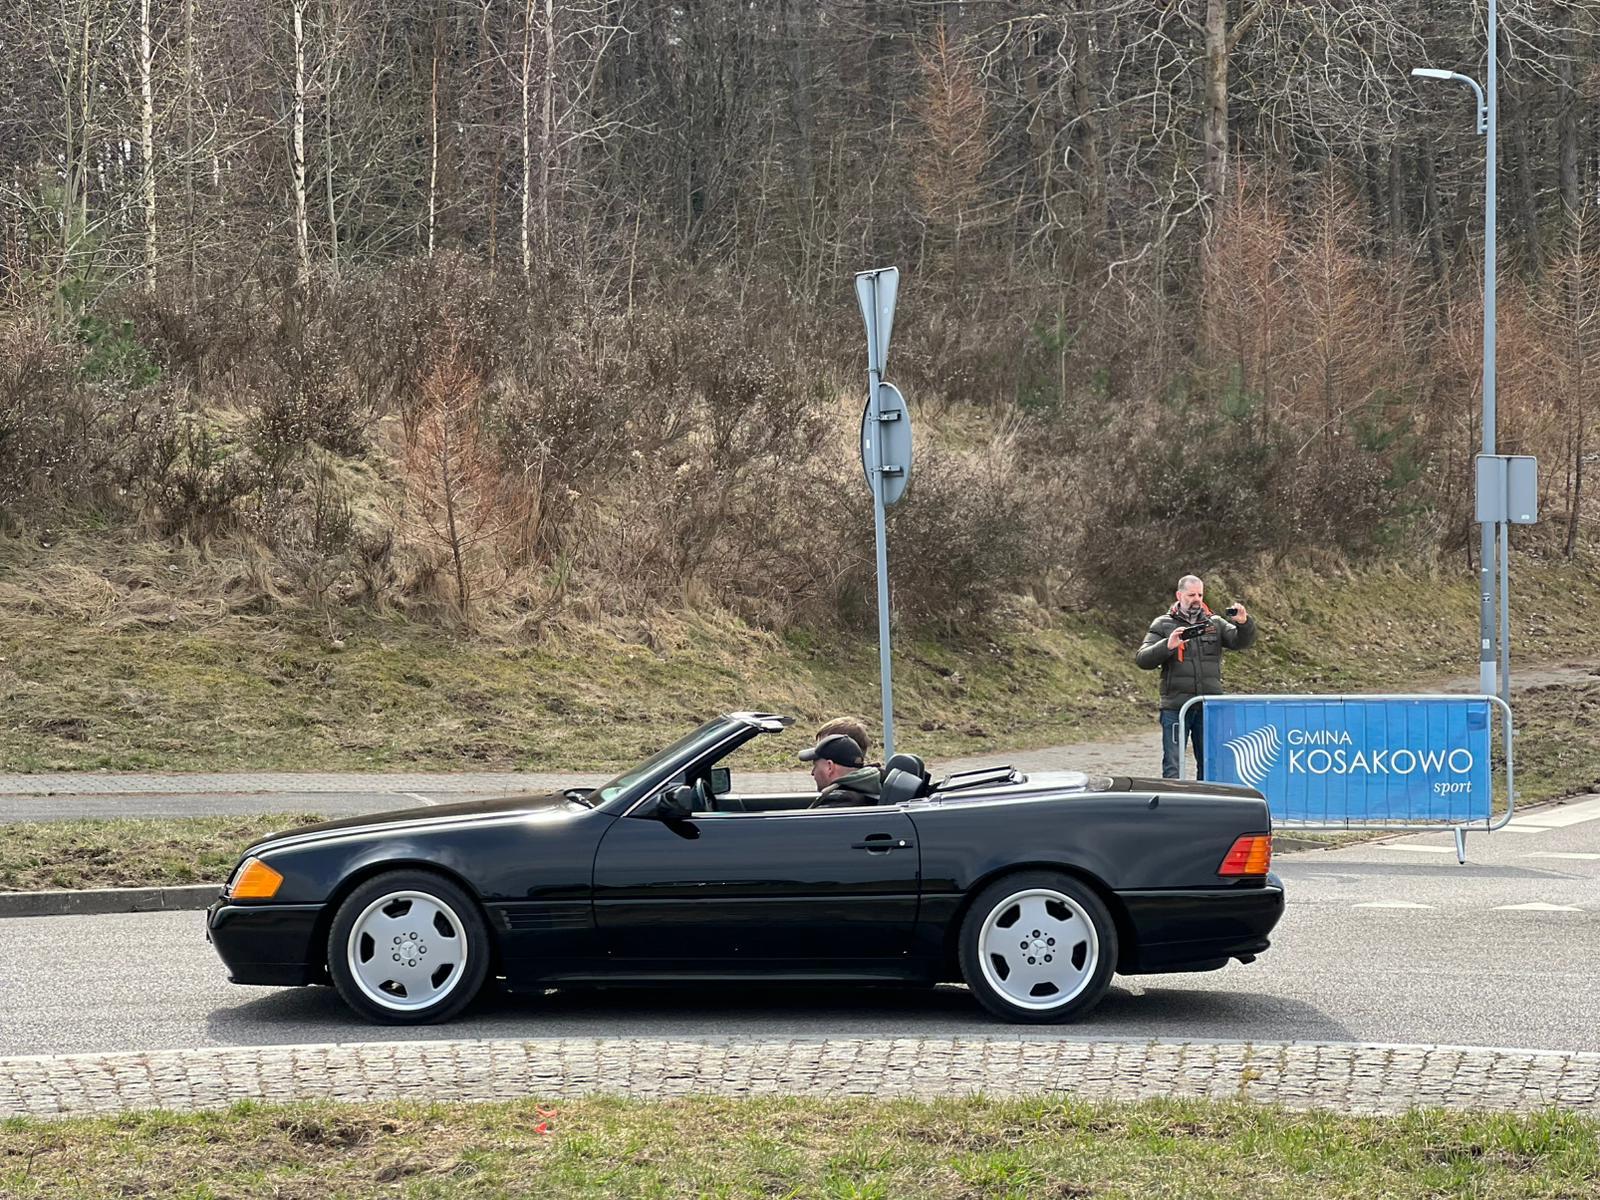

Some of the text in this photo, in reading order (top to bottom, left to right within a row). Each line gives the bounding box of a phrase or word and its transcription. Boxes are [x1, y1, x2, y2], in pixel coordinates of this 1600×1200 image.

[1287, 729, 1352, 745] GMINA
[1289, 748, 1473, 774] KOSAKOWO
[1433, 781, 1472, 796] sport
